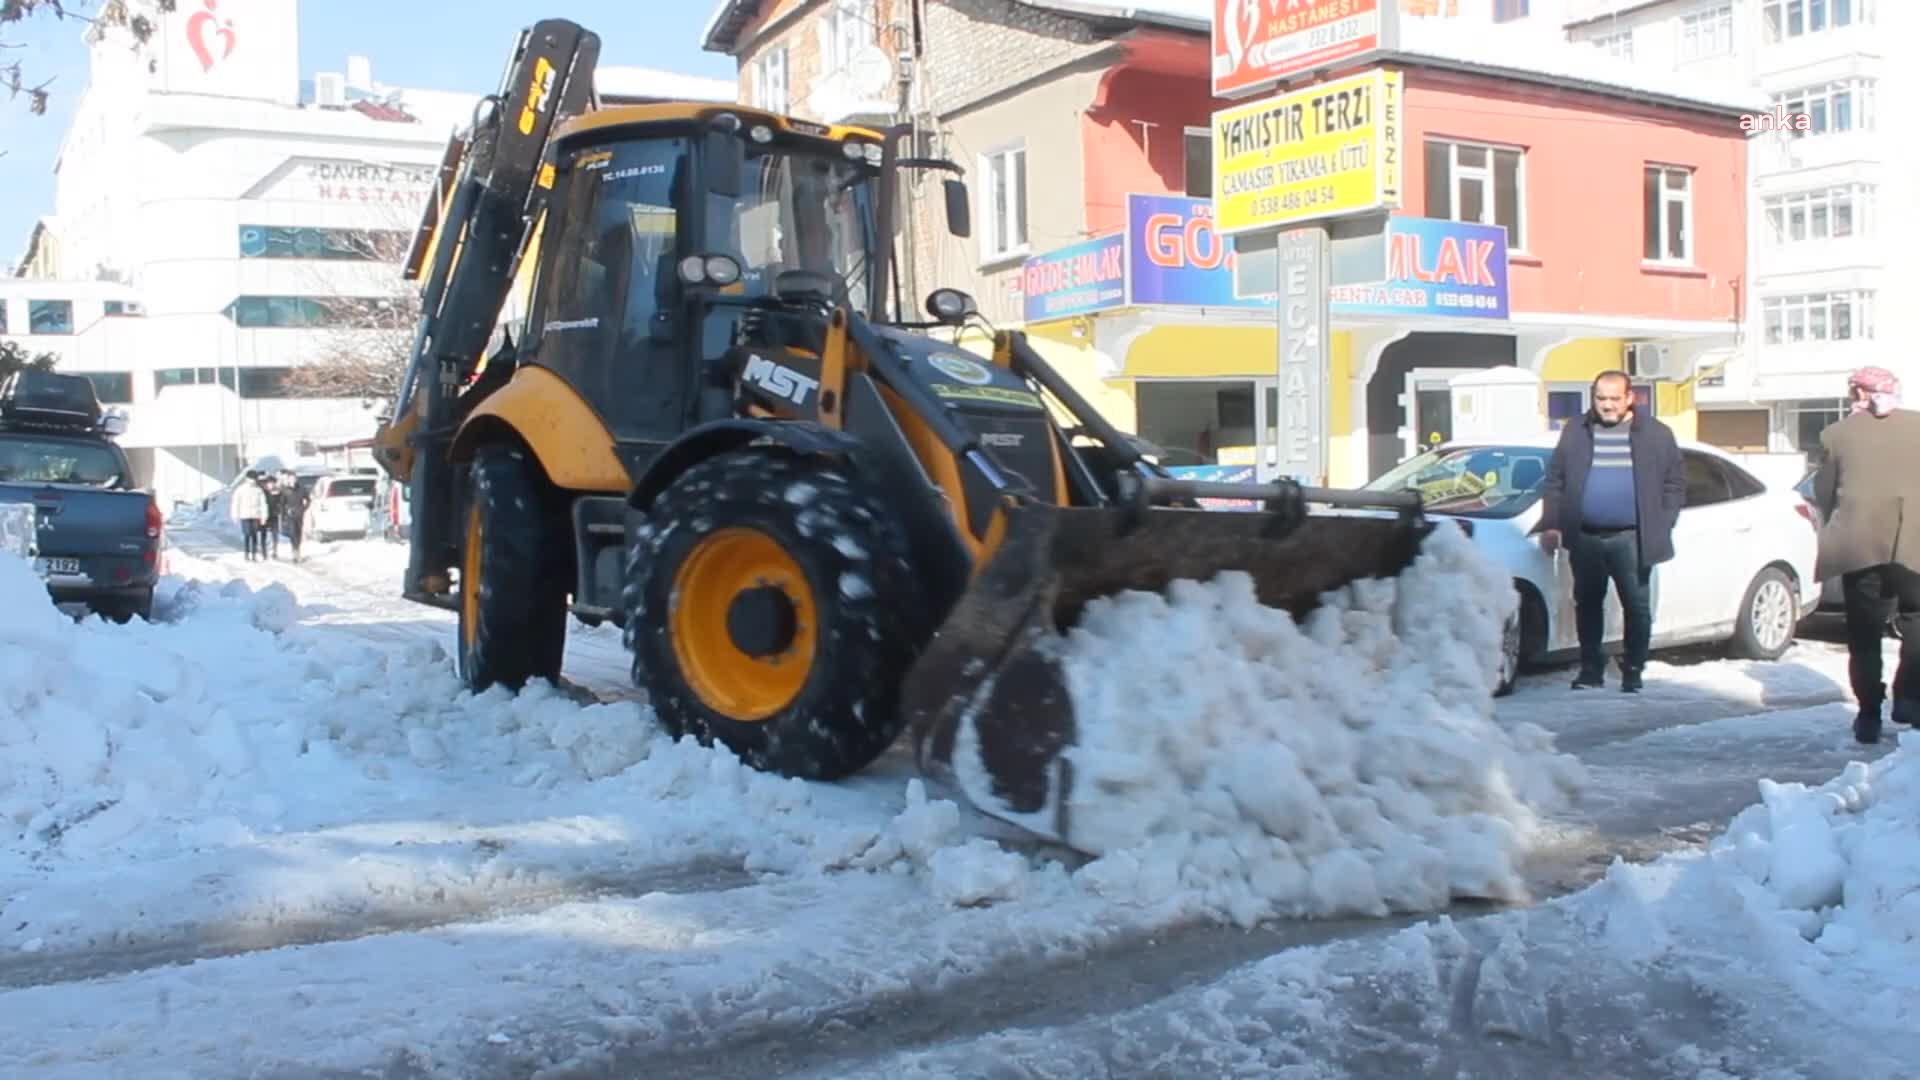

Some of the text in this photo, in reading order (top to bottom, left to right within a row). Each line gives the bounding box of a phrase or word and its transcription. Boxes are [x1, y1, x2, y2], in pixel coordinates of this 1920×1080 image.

[1220, 102, 1304, 159] YAKIŞTIR
[1260, 196, 1279, 215] 538
[1282, 192, 1301, 210] 486
[742, 354, 819, 405] MST
